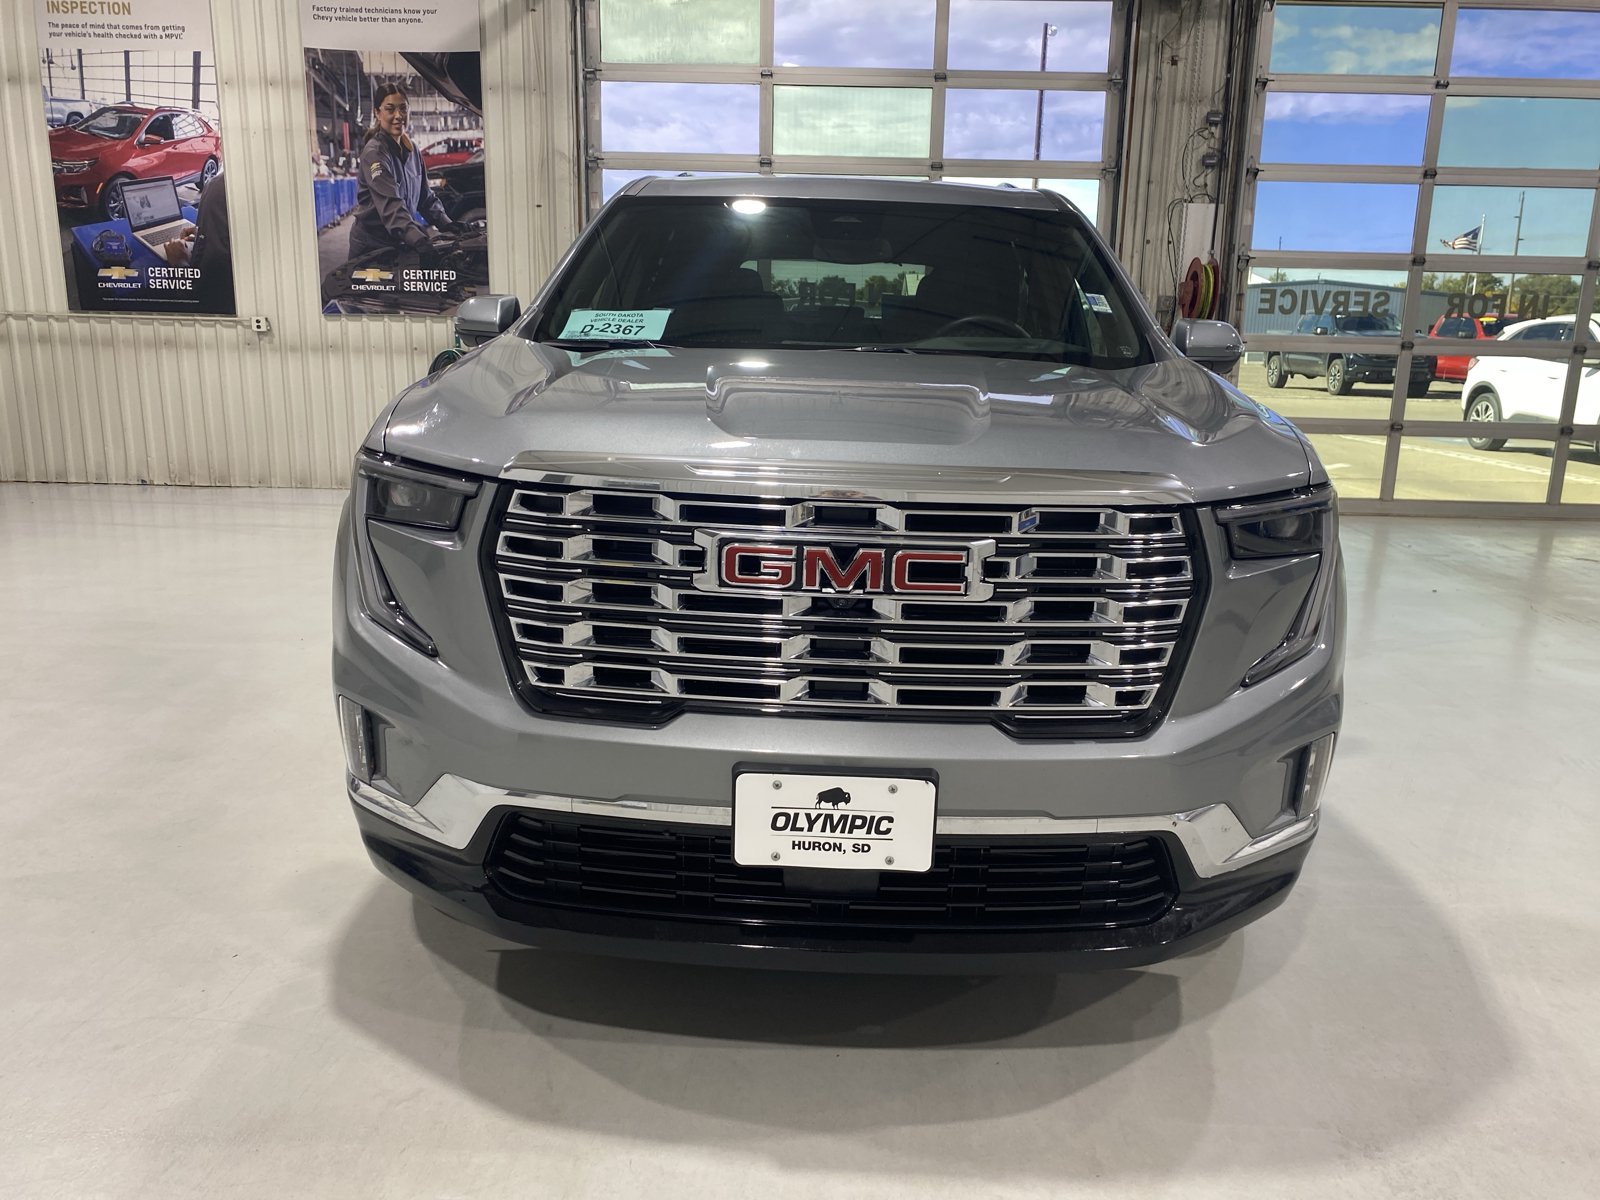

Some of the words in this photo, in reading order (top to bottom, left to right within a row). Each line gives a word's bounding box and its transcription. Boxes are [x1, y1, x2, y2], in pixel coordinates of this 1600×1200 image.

[46, 1, 131, 15] INSPECTION
[312, 5, 338, 14] Factory
[312, 14, 333, 22] Chevy
[359, 15, 380, 23] better
[161, 24, 186, 32] getting
[148, 267, 201, 279] CERTIFIED
[402, 269, 457, 280] CERTIFIED
[149, 279, 193, 290] SERVICE
[403, 281, 448, 292] SERVICE
[580, 323, 645, 336] D-2367
[722, 543, 967, 593] GMC
[770, 812, 894, 836] OLYMPIC
[791, 840, 847, 854] HURON,
[851, 843, 871, 854] SD
